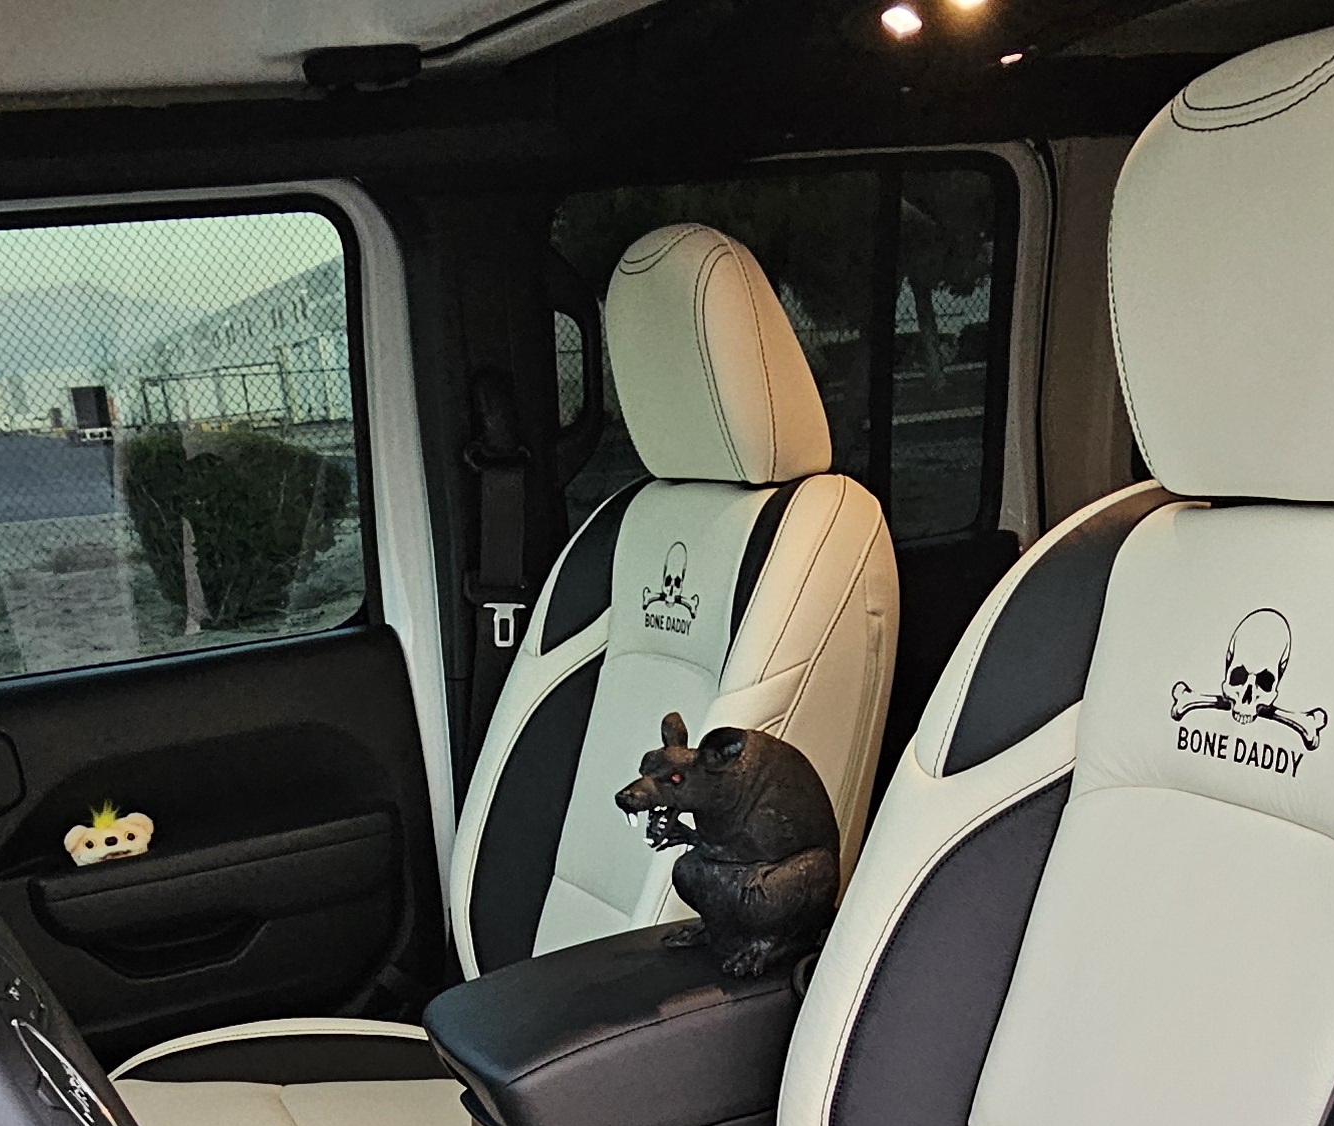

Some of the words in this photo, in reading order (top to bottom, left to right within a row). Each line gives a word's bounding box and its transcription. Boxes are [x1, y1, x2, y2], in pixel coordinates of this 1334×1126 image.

[645, 613, 665, 630] BONE
[666, 616, 691, 636] DADDY
[1177, 727, 1229, 760] BONE
[1233, 738, 1304, 778] DADDY
